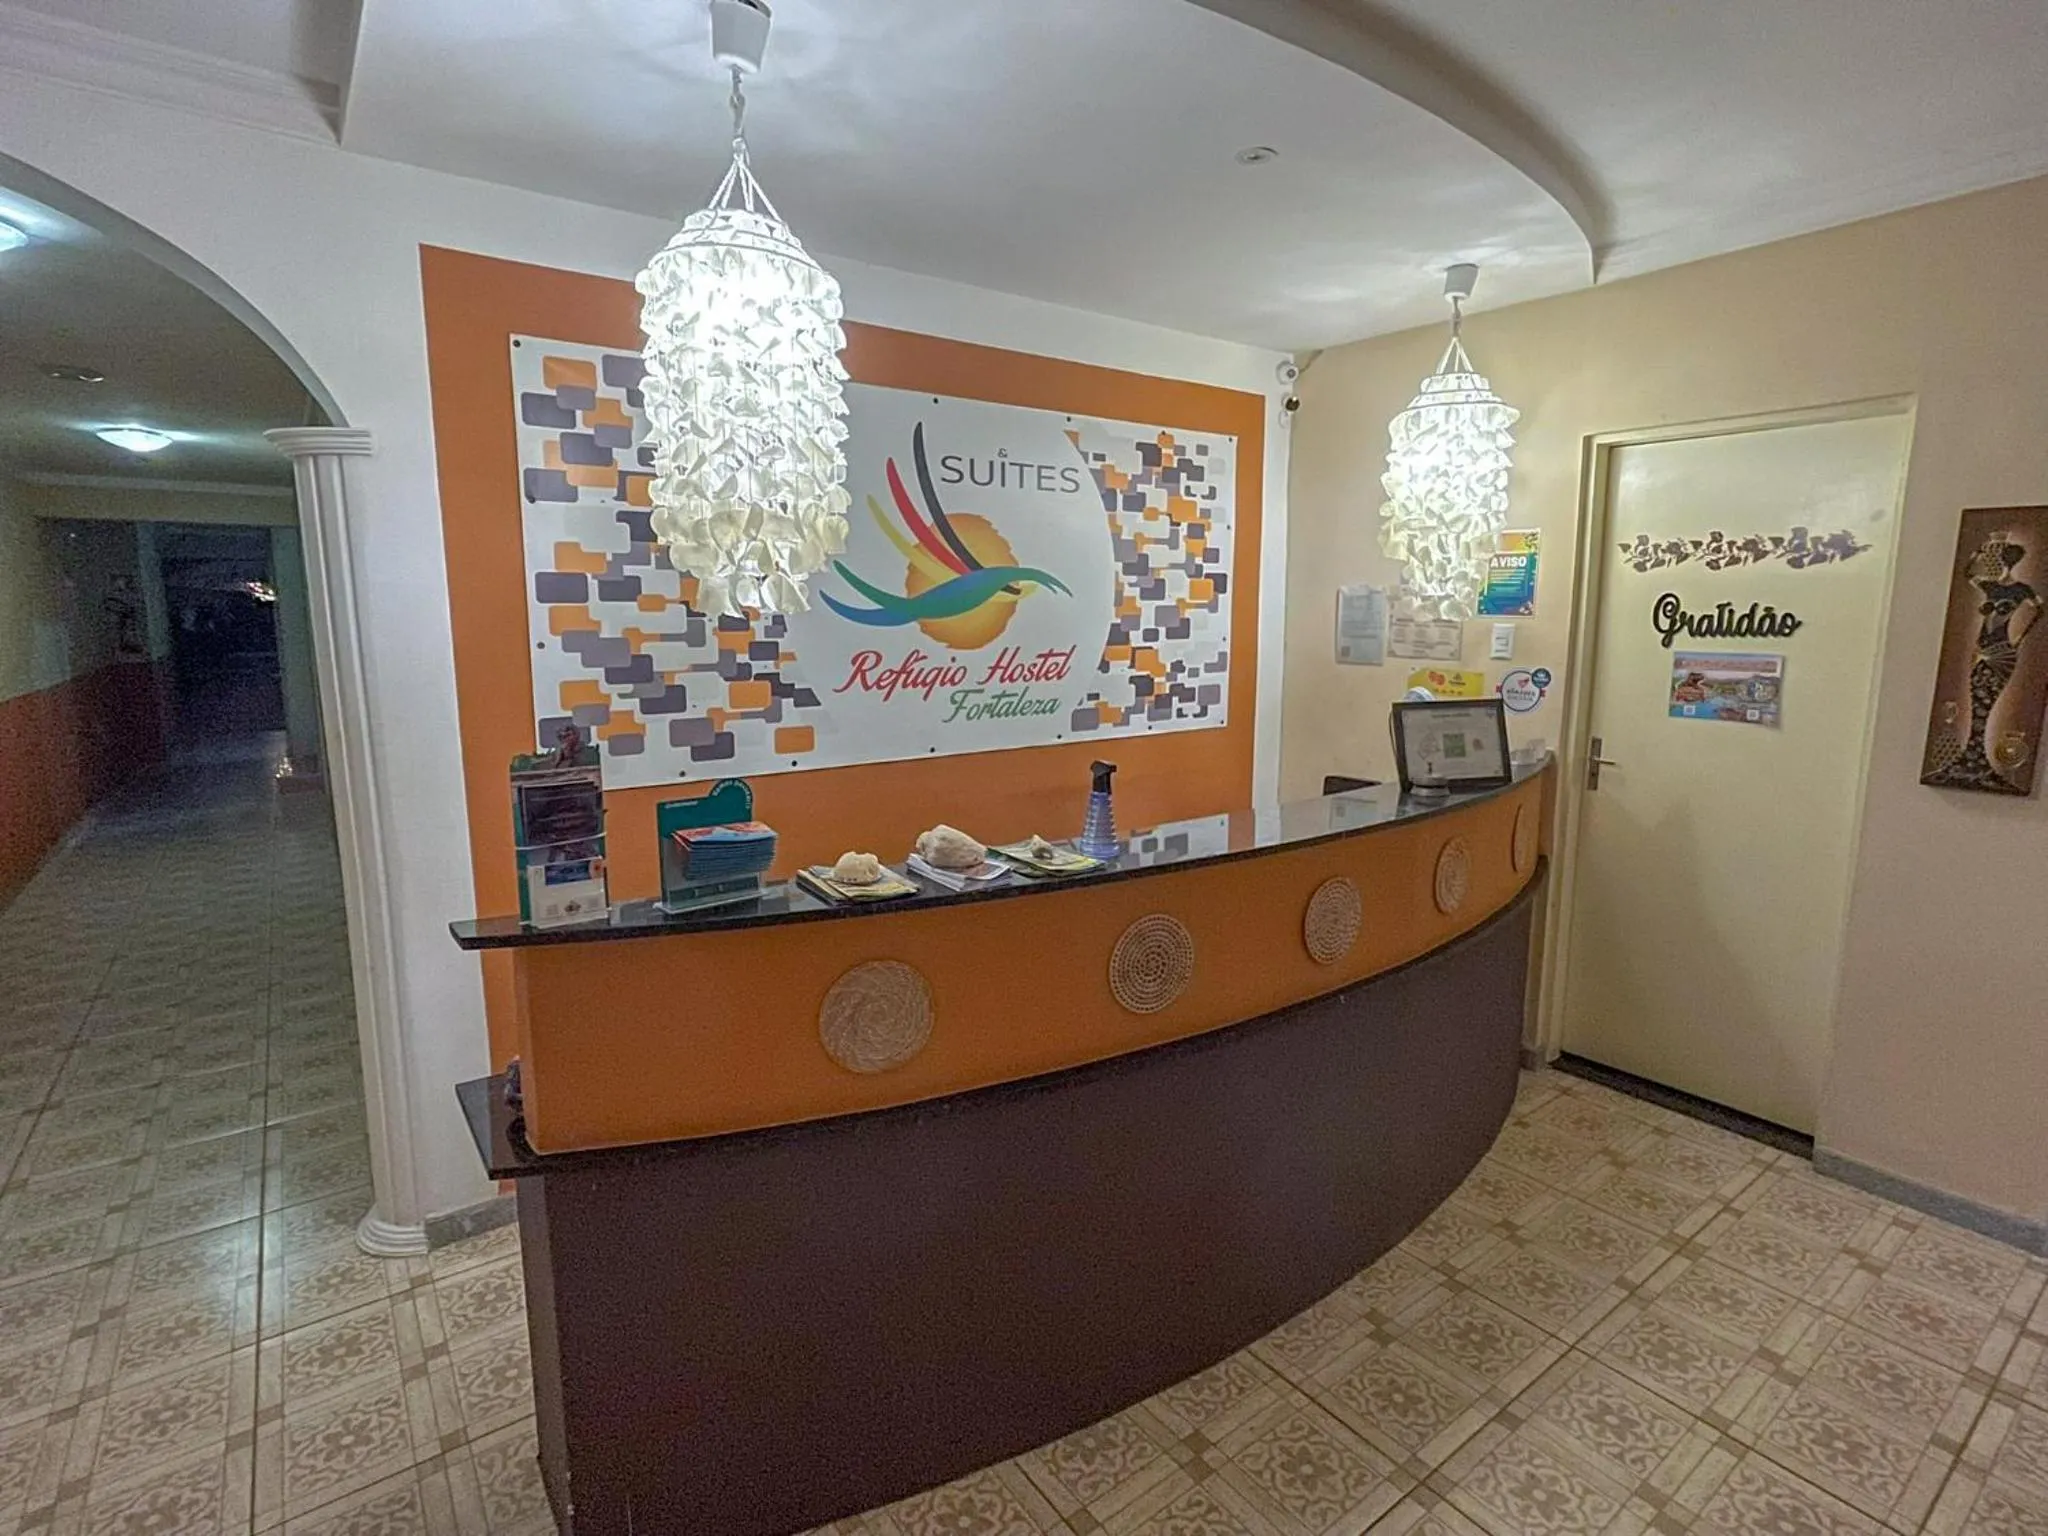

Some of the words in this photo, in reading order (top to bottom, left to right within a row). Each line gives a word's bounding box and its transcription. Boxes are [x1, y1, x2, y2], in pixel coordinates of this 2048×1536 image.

[997, 448, 1008, 458] &
[940, 455, 1080, 493] SUITES
[1490, 556, 1527, 568] AVISO
[1653, 593, 1803, 648] Gratidão
[977, 644, 1077, 685] Hostel
[942, 687, 1062, 723] Fortaleza
